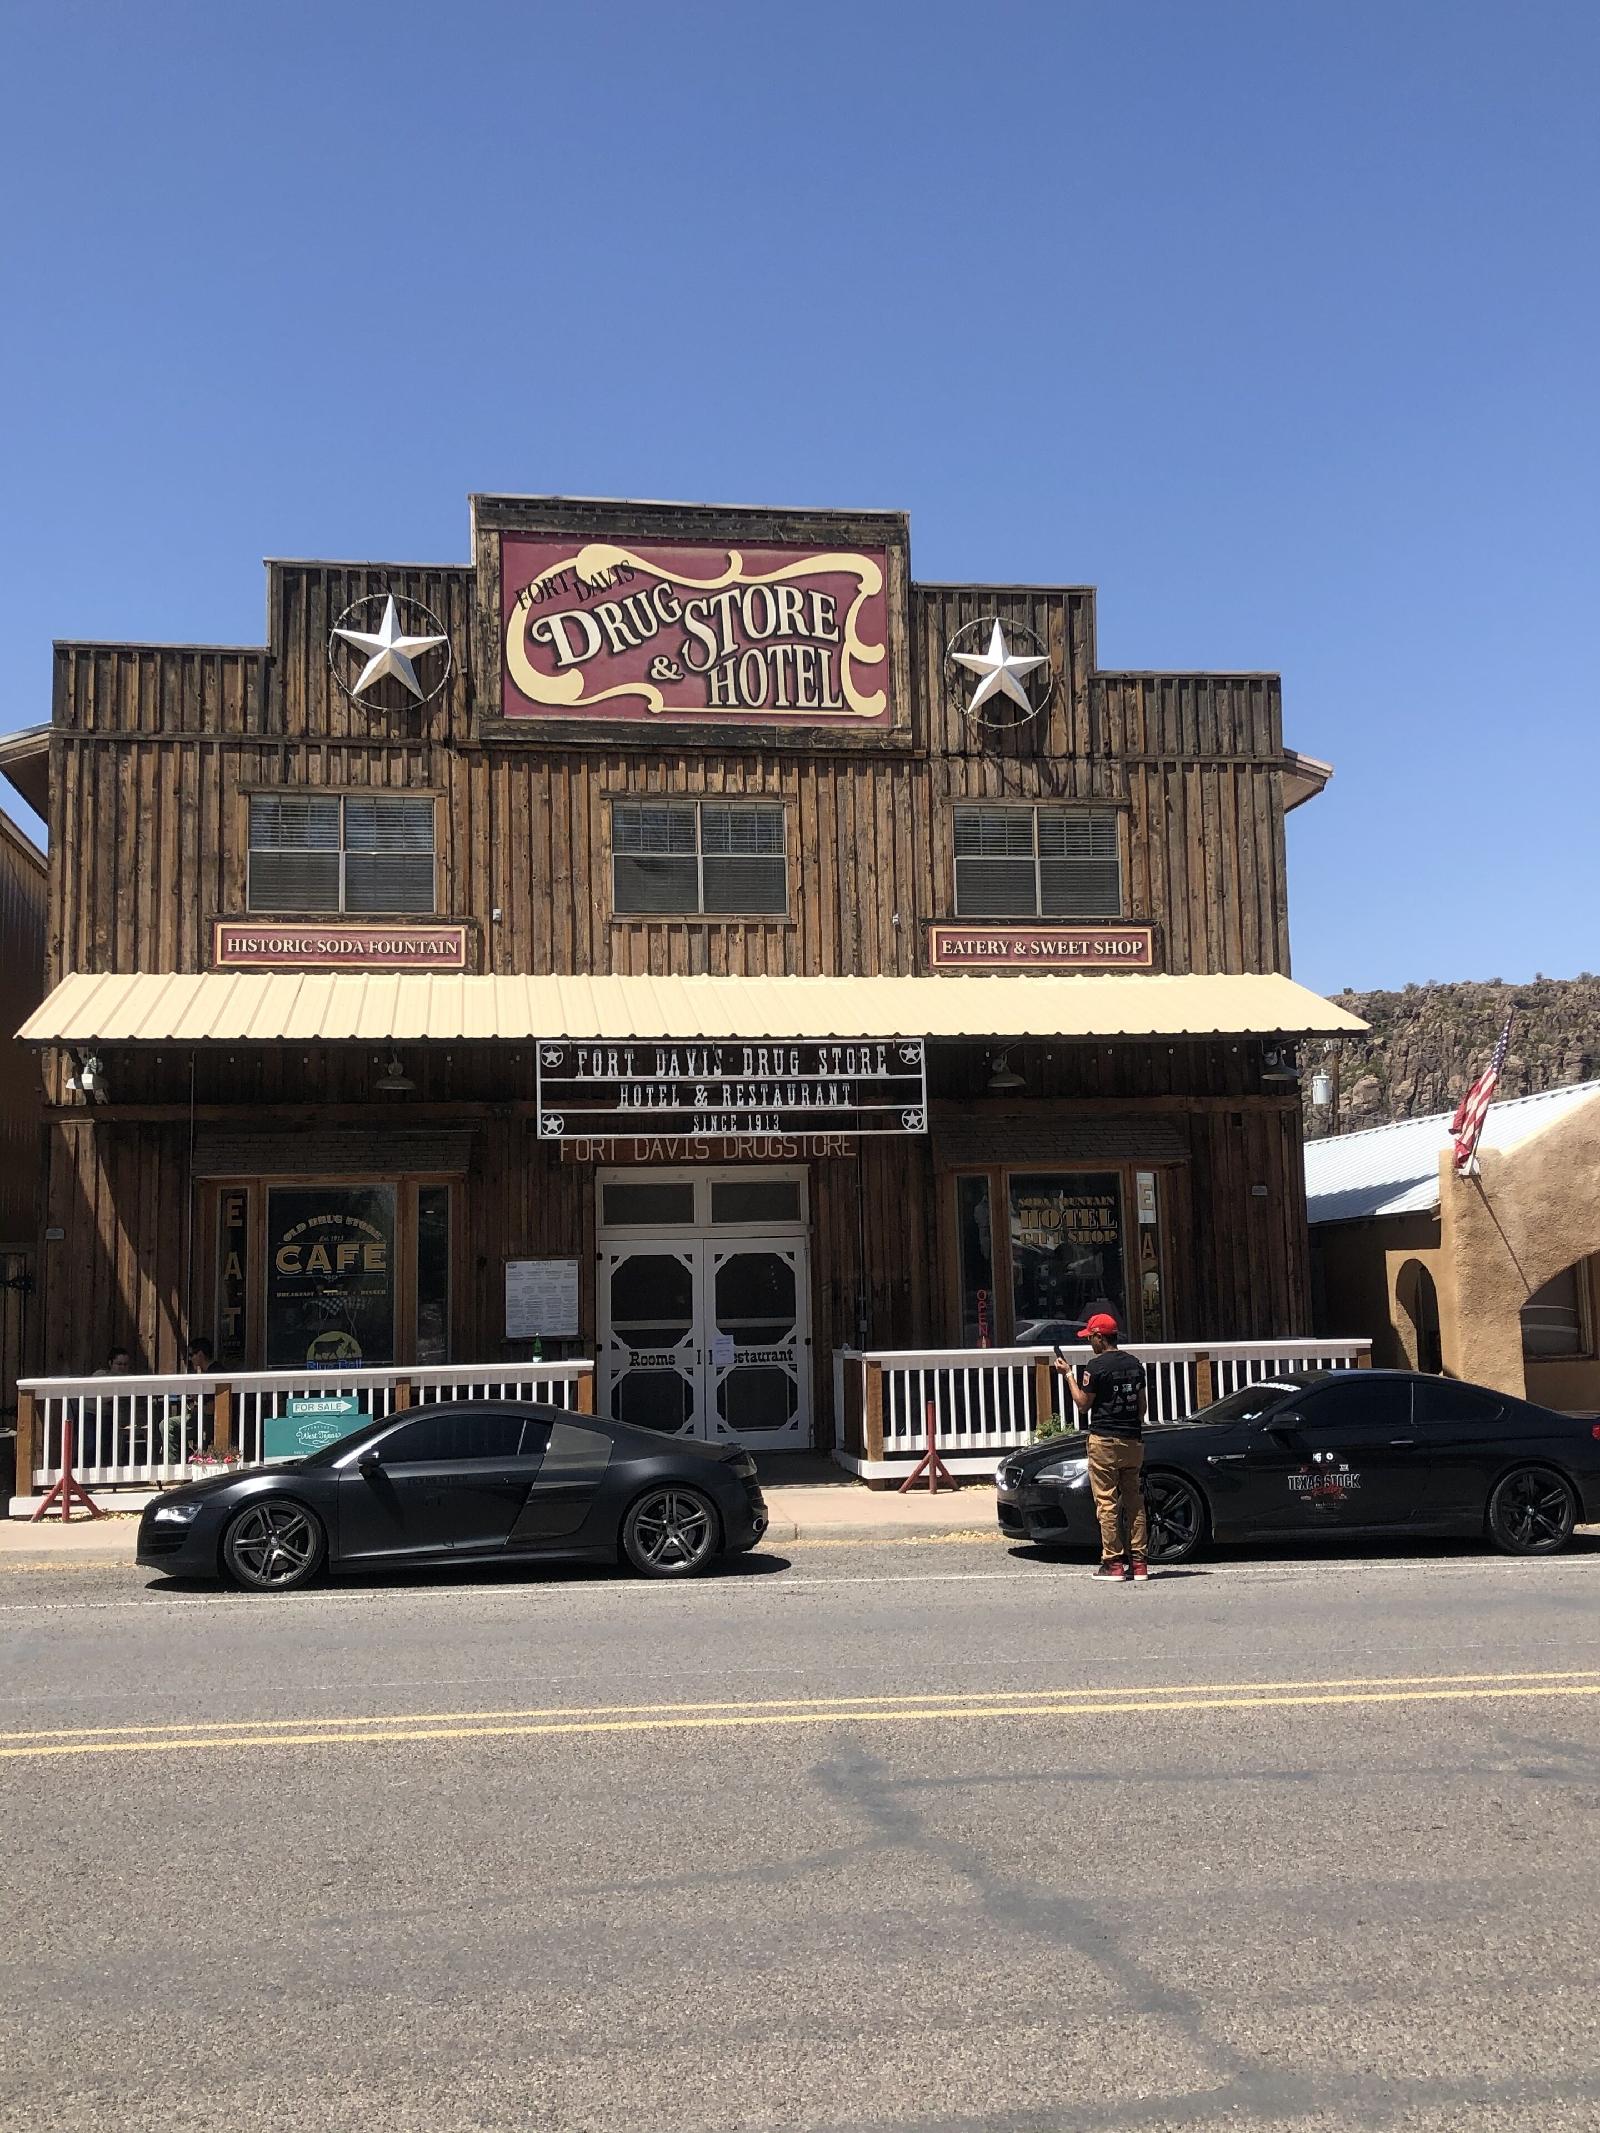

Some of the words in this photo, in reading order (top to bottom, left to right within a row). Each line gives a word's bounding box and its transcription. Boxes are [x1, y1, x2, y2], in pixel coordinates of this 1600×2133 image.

[515, 571, 571, 612] FORT
[573, 559, 636, 604] DAVIS
[532, 582, 685, 668] DRUG
[681, 584, 841, 672] STORE
[650, 656, 684, 681] &
[708, 644, 844, 709] HOTEL
[227, 938, 314, 954] HISTORIC
[317, 940, 364, 954] SODA
[368, 941, 458, 955] FOUNTAIN
[941, 940, 1010, 955] EATERY
[1013, 941, 1027, 955] &
[1030, 940, 1090, 955] SWEET
[1094, 940, 1143, 955] SHOP
[577, 1048, 635, 1077] FORT
[655, 1048, 722, 1076] DAVIS
[743, 1047, 800, 1076] DRUG
[818, 1045, 888, 1075] STORE
[619, 1084, 681, 1107] HOTEL
[694, 1084, 708, 1107] &
[722, 1083, 851, 1107] RESTAURANT
[693, 1114, 737, 1132] SINCE
[747, 1114, 780, 1132] 1913
[559, 1138, 617, 1162] FORT
[634, 1137, 710, 1161] DAVIS
[724, 1135, 858, 1159] DRUGSTORE
[1019, 1209, 1117, 1229] HOTEL
[1068, 1230, 1118, 1245] SHOP
[223, 1197, 243, 1337] EAT
[276, 1243, 387, 1275] CAFE
[976, 1289, 988, 1336] OPEN
[629, 1351, 676, 1366] Rooms
[734, 1349, 793, 1363] estaurant
[295, 1403, 315, 1411] FOR
[317, 1403, 342, 1411] SALE
[1288, 1475, 1321, 1490] TEXAS
[1323, 1474, 1361, 1489] STOCK
